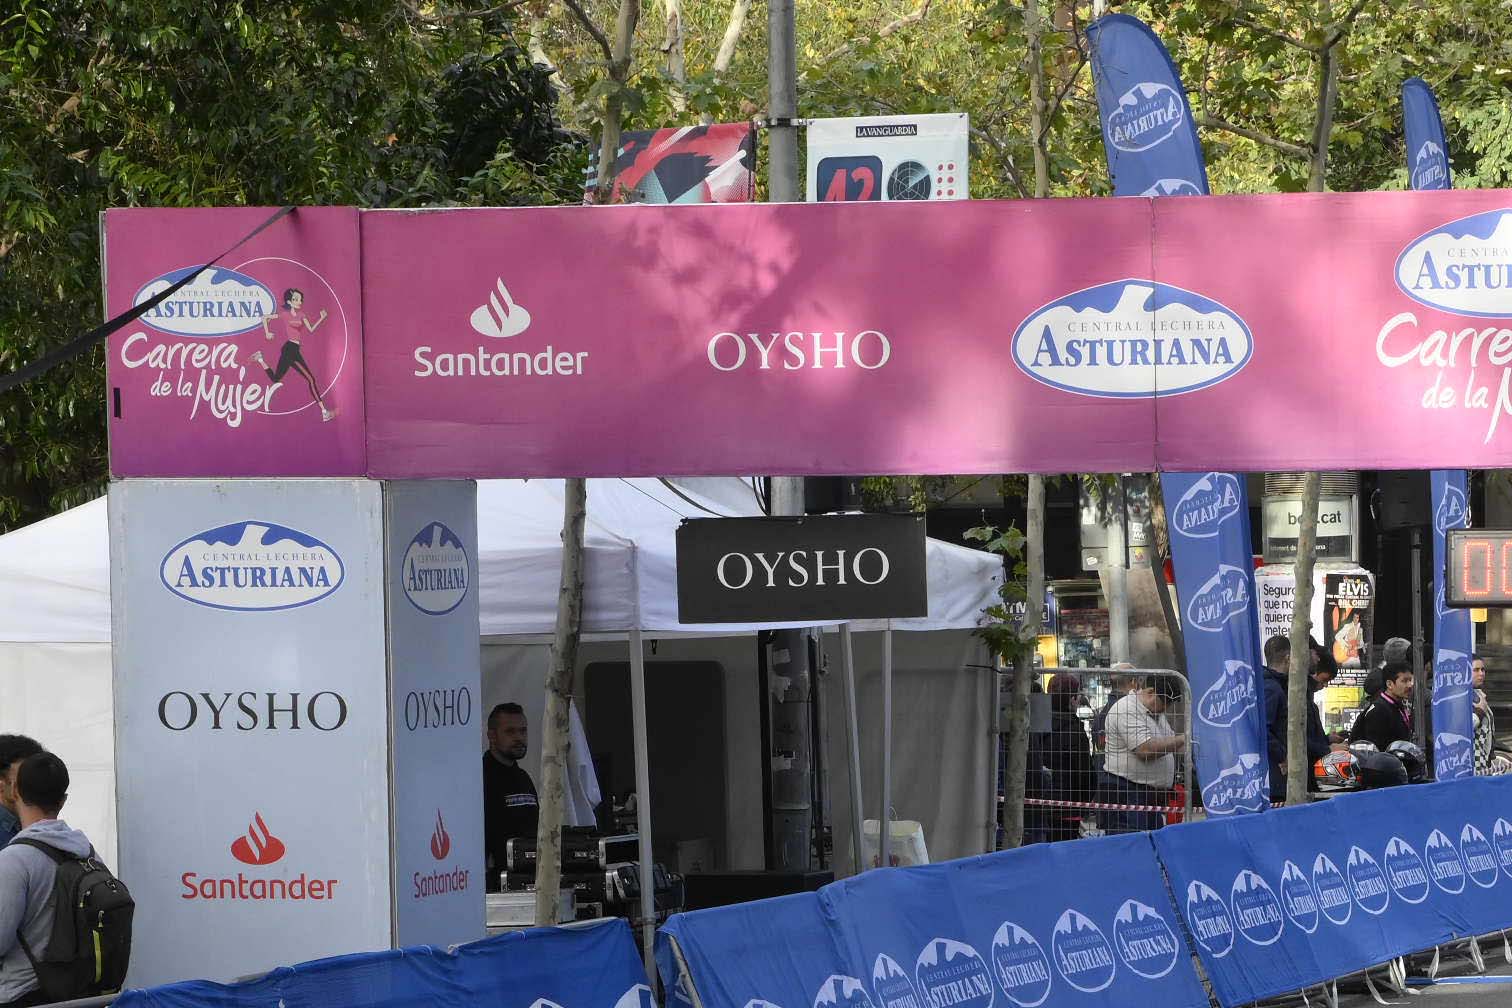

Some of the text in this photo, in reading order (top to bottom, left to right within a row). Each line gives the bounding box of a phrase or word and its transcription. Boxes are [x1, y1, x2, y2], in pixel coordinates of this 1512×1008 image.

[170, 289, 210, 297] ENTRAL
[1067, 319, 1226, 333] CENTRAL LECHERA
[121, 332, 239, 368] Carrera
[413, 345, 589, 378] Santander
[707, 330, 891, 371] OYSHO
[1030, 324, 1235, 368] ASTURIANA
[150, 366, 283, 427] de la Mujer
[1422, 369, 1458, 409] de
[1464, 367, 1489, 408] la
[175, 554, 332, 588] ASTURIANA
[202, 552, 325, 561] CENTRAL LECHERA
[716, 548, 890, 589] OYSHO
[407, 557, 466, 592] ASTURIANA
[1338, 583, 1369, 596] ELVIS
[157, 691, 348, 731] OYSHO
[405, 686, 471, 732] OYSHO
[181, 872, 338, 900] Santander
[413, 864, 469, 899] Santander
[997, 957, 1049, 990] ASTURIANA
[1057, 942, 1112, 976] ASTURIANA
